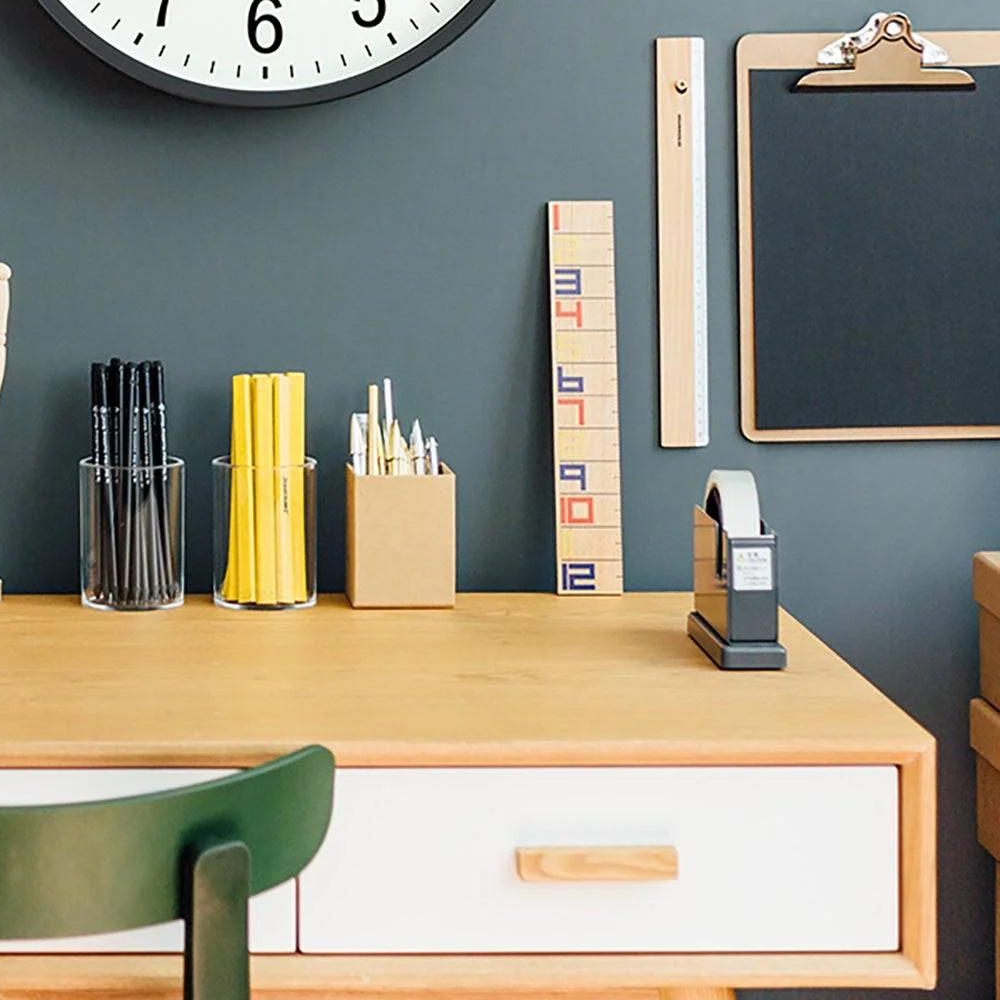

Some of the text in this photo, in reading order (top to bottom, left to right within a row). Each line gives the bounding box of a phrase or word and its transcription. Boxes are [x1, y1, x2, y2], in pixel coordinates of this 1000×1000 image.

[554, 268, 582, 296] 3
[557, 366, 584, 393] 6
[557, 399, 585, 426] 7
[559, 464, 586, 490] 9
[560, 497, 594, 524] 10
[561, 563, 595, 591] 12
